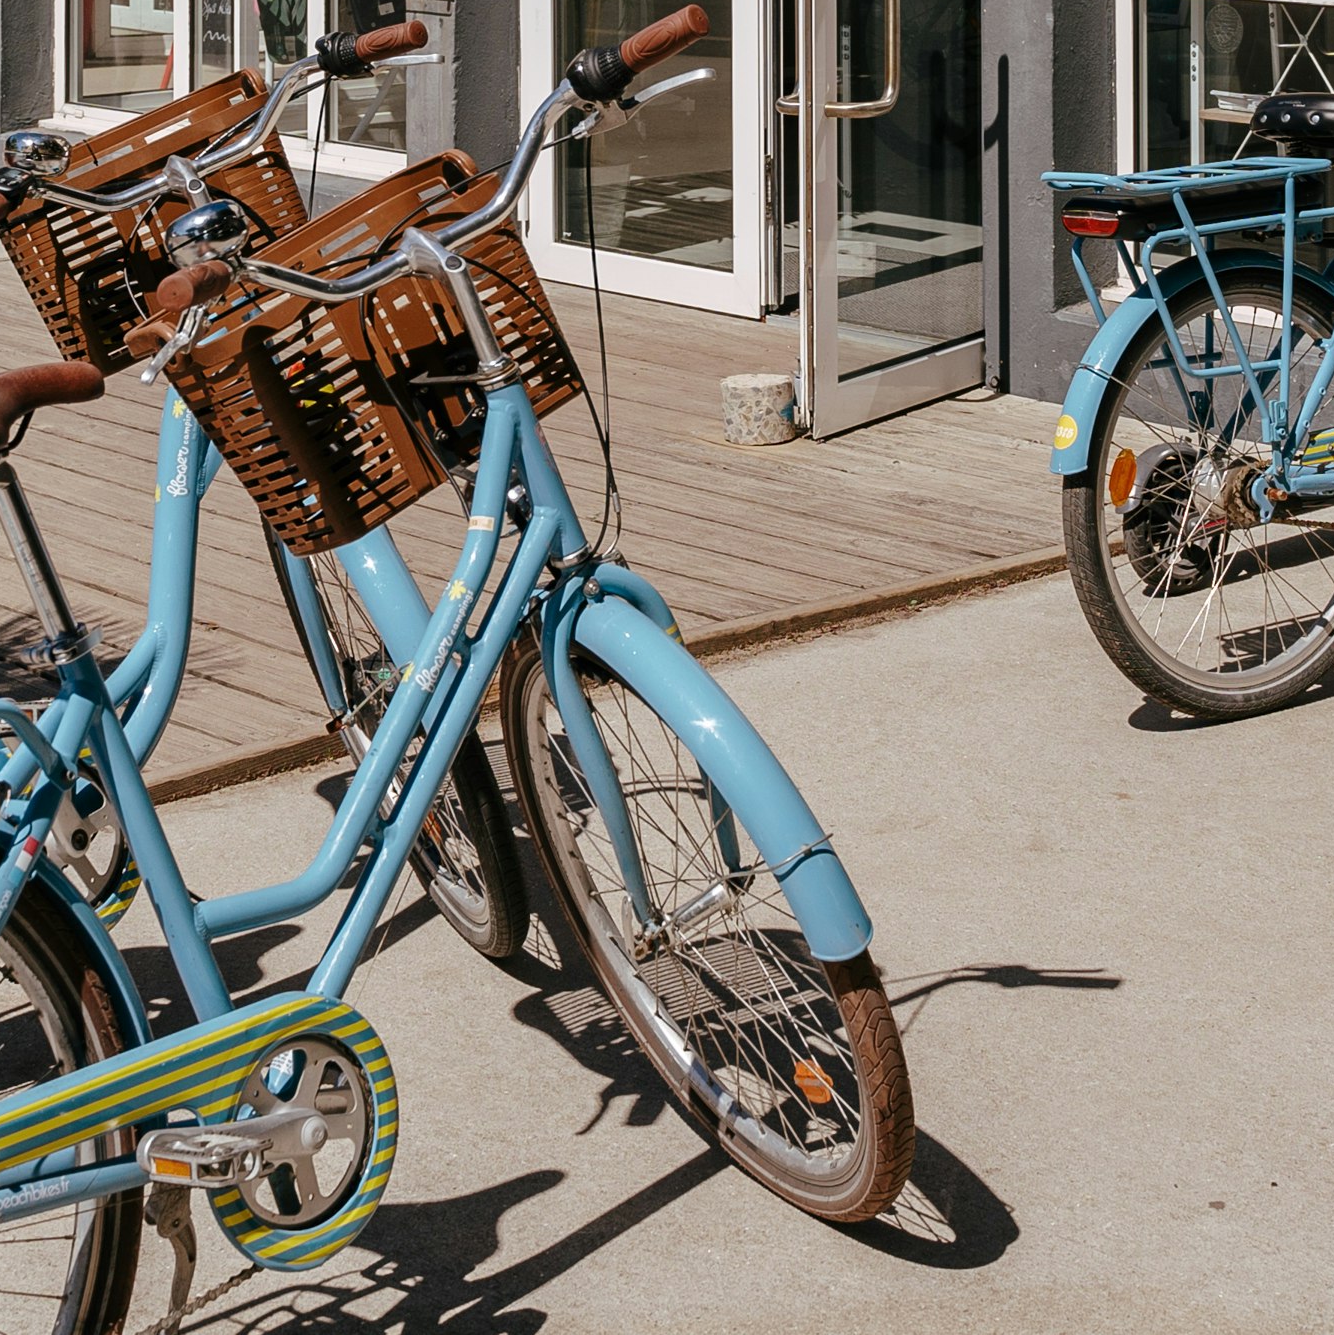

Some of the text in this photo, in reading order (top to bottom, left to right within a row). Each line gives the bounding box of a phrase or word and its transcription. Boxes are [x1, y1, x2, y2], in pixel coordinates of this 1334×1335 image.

[167, 446, 189, 497] flower
[416, 589, 474, 693] flower campings
